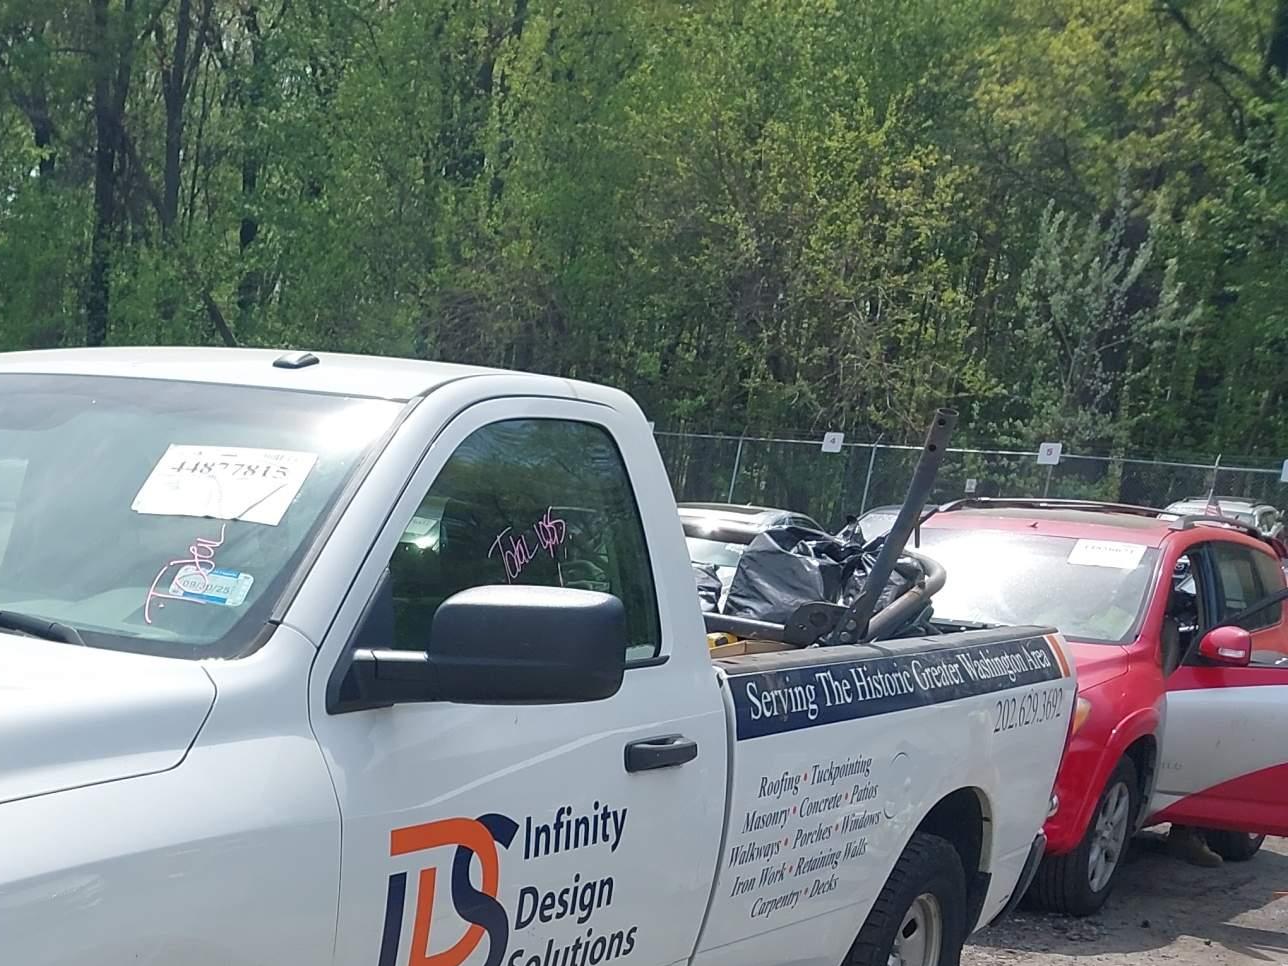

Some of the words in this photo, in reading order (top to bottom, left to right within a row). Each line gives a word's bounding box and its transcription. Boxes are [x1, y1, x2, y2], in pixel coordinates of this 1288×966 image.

[746, 676, 819, 721] Serving
[815, 669, 853, 708] The
[850, 662, 914, 702] Historic
[911, 660, 965, 690] Greater
[956, 649, 1026, 682] Washington
[1022, 646, 1051, 673] Area
[993, 687, 1063, 734] 202.629.3692
[758, 771, 801, 800] Roofing
[810, 754, 873, 786] Tuckpointing
[523, 800, 628, 861] Infinity
[741, 807, 791, 834] Masonry
[799, 793, 842, 818] Concrete
[849, 781, 879, 805] Patios
[728, 838, 782, 868] Walkways
[792, 822, 833, 849] Porches
[841, 810, 882, 835] Windows
[730, 876, 756, 897] Iron
[758, 862, 787, 888] Work
[793, 848, 842, 877] Retaining
[842, 837, 868, 862] Walls
[514, 873, 614, 930] Design
[750, 890, 803, 918] Carpentry
[809, 873, 839, 898] Decks
